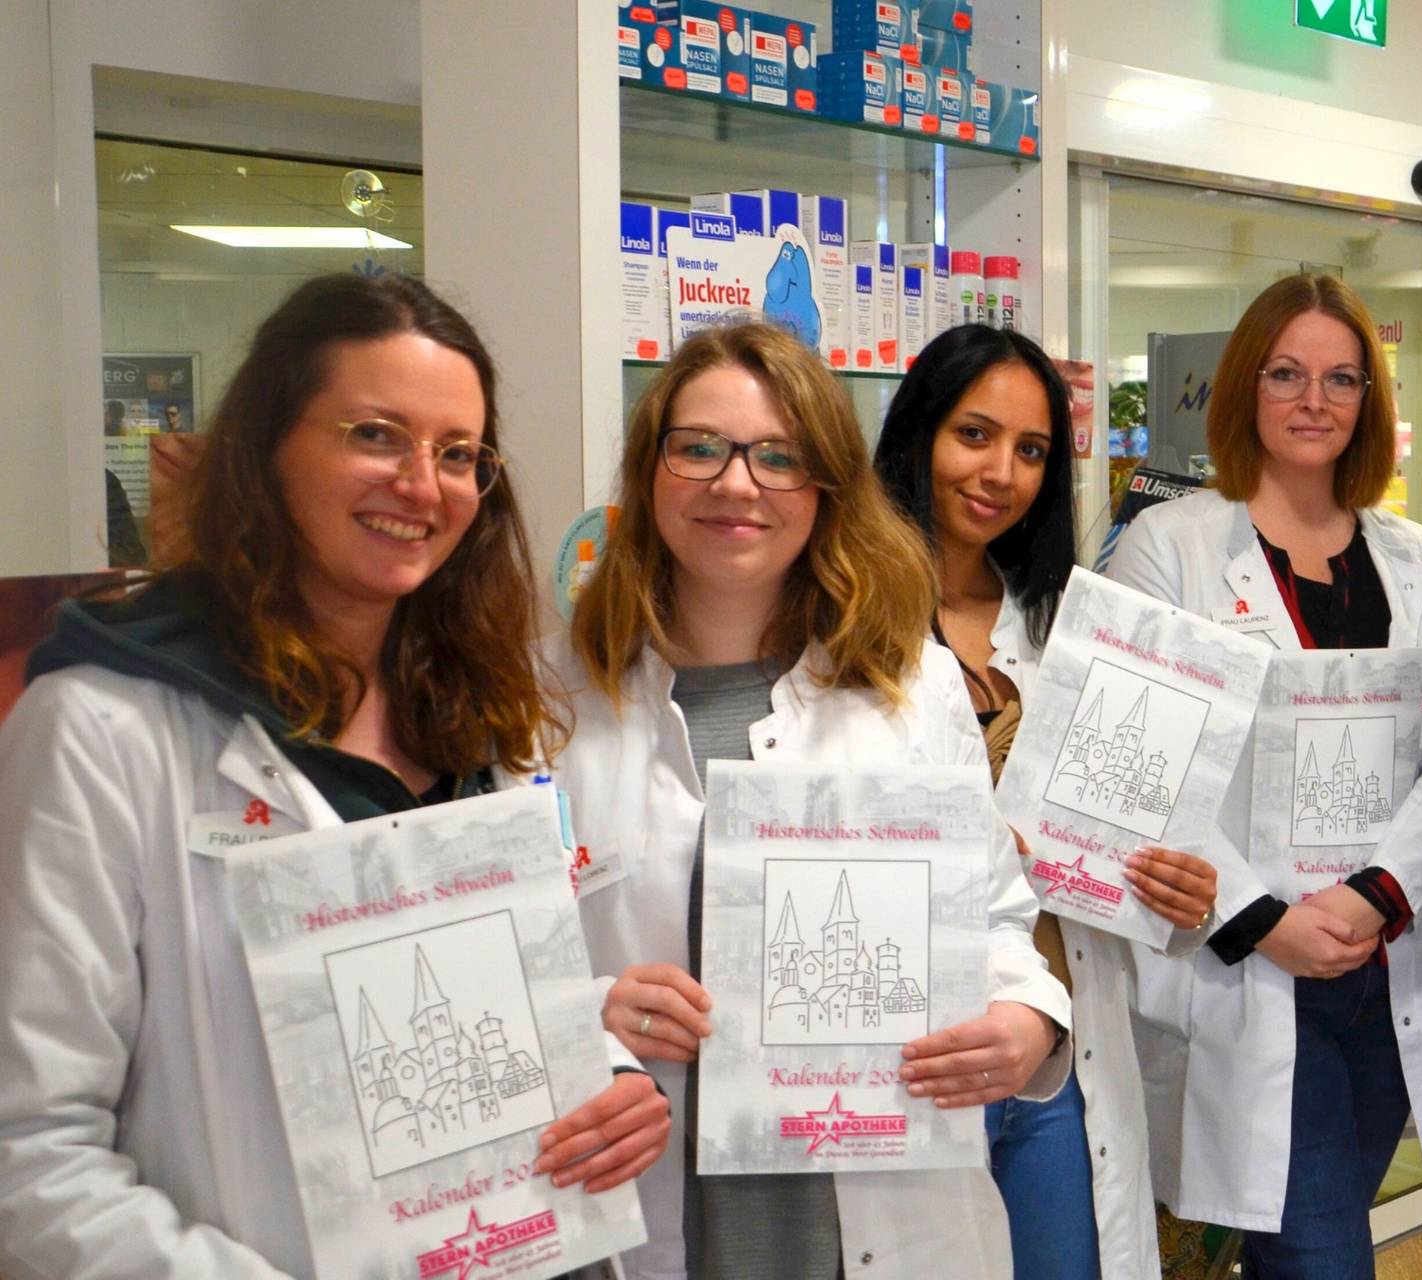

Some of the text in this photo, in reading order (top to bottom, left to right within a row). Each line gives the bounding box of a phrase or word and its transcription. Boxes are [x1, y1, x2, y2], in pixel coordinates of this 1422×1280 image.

[879, 24, 898, 37] NaCl
[686, 49, 717, 63] NASEN
[755, 63, 785, 77] NASEN
[865, 83, 884, 96] NaCl
[905, 92, 924, 105] NaCl
[942, 99, 960, 112] NaCl
[695, 218, 731, 237] Linola
[621, 236, 650, 250] Linola
[821, 231, 842, 243] Linola
[676, 257, 719, 272] Wenn der
[679, 277, 752, 306] Juckreiz
[1144, 478, 1192, 500] Umsch
[1092, 627, 1226, 690] Historisches Schwelm
[1291, 690, 1402, 706] Historisches Schwelm
[756, 818, 941, 841] Historisches Schwelm
[1039, 819, 1105, 853] Kalender
[1294, 857, 1356, 874] Kalender
[1033, 863, 1122, 901] STERN APOTHEKE
[304, 864, 516, 932] Historisches Schwelm
[767, 1062, 904, 1087] Kalender 20
[780, 1119, 906, 1132] STERN APOTHEKE
[388, 1162, 535, 1225] Kalender 20
[419, 1246, 470, 1273] STERN
[474, 1215, 556, 1254] APOTHEKE
